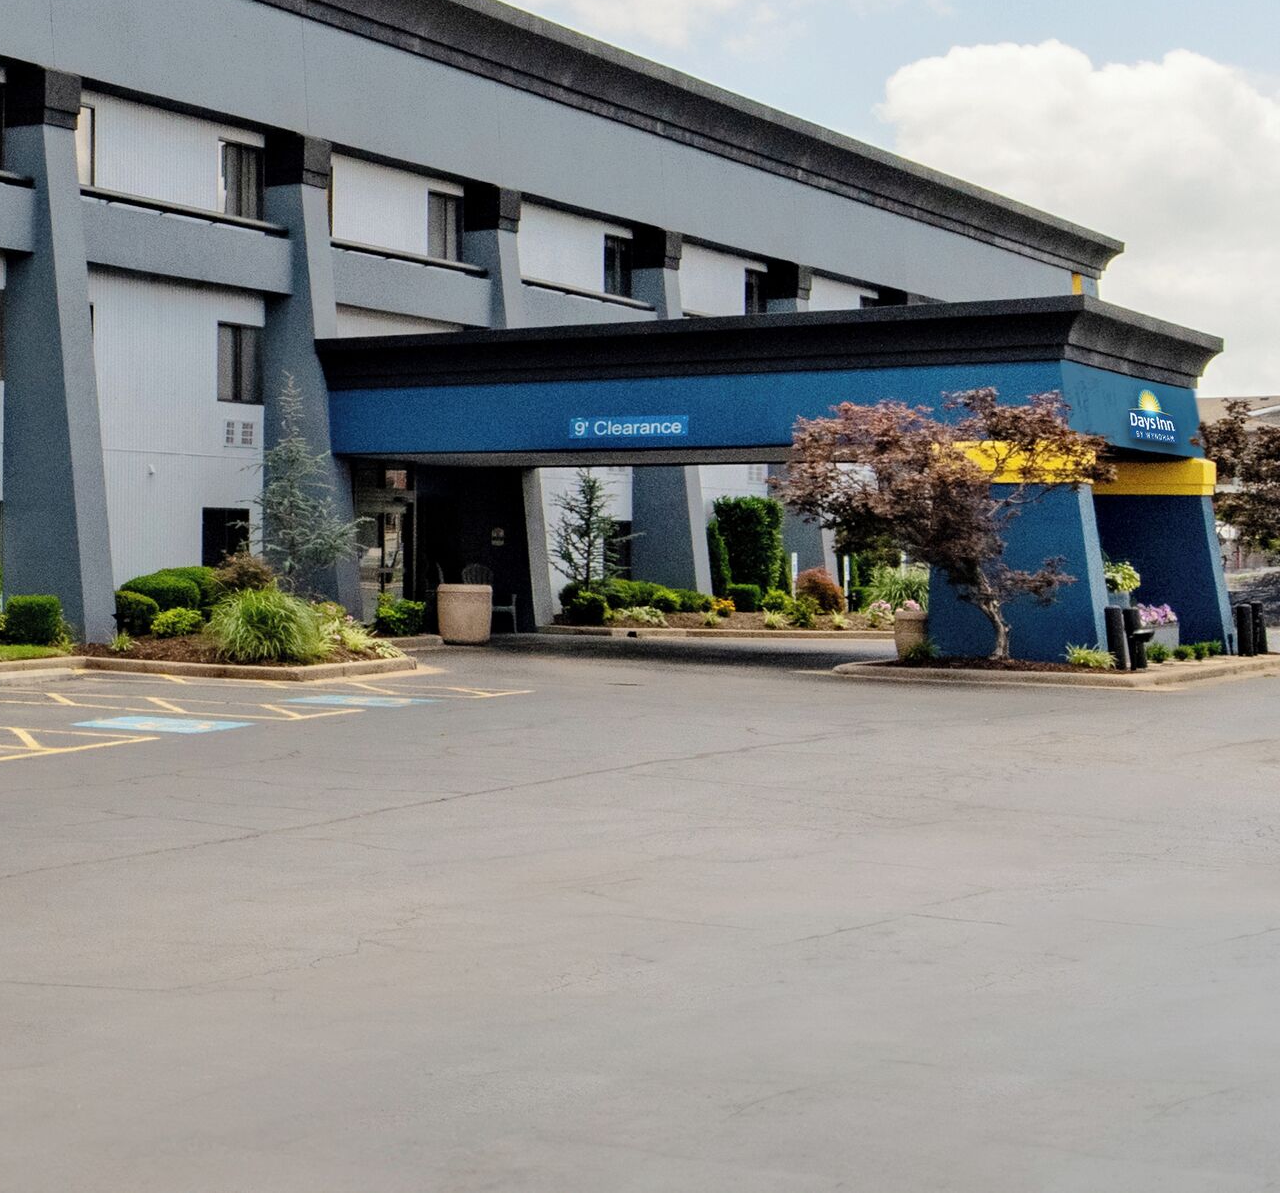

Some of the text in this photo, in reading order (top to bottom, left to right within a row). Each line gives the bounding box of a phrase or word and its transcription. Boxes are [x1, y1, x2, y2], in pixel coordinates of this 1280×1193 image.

[574, 420, 682, 436] 9' Clearance
[1129, 412, 1176, 432] Days Inn
